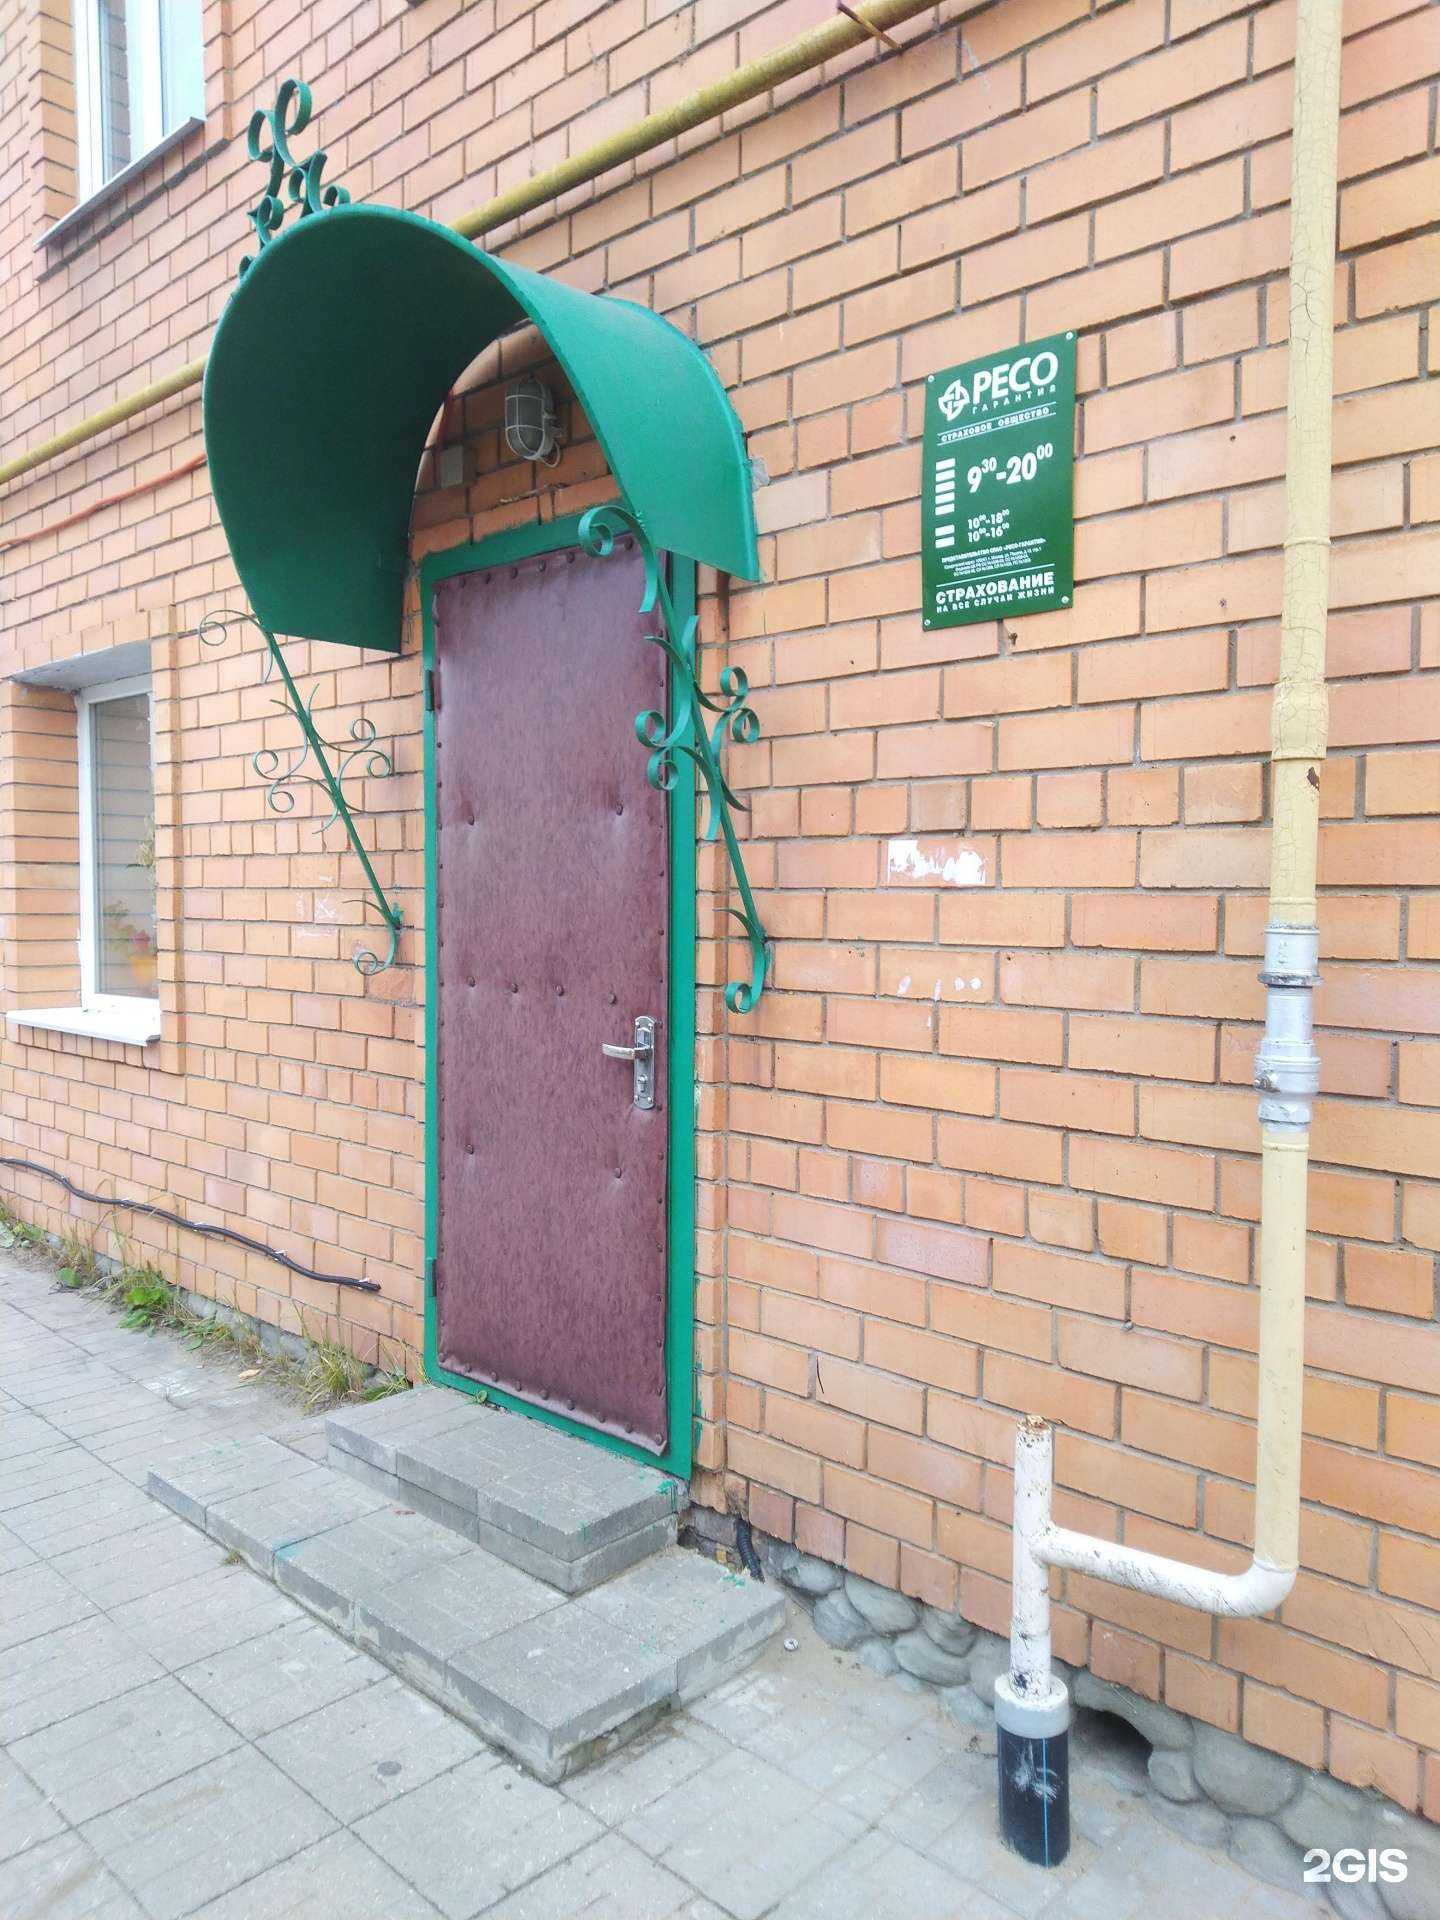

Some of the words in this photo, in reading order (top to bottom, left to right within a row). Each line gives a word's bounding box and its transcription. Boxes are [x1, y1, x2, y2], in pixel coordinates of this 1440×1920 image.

[972, 352, 1058, 405] РЕСО
[972, 384, 1056, 414] ГАРАНТИЯ
[941, 422, 992, 441] СТРАХОВОЕ
[998, 407, 1049, 427] ОБЩЕСТВО
[936, 572, 1054, 604] СТРАХОВАНИЕ
[936, 605, 948, 613] НА
[952, 601, 970, 611] ВСЕ
[974, 593, 1013, 607] СЛУЧАИ
[1018, 587, 1055, 599] ЖИЗНИ
